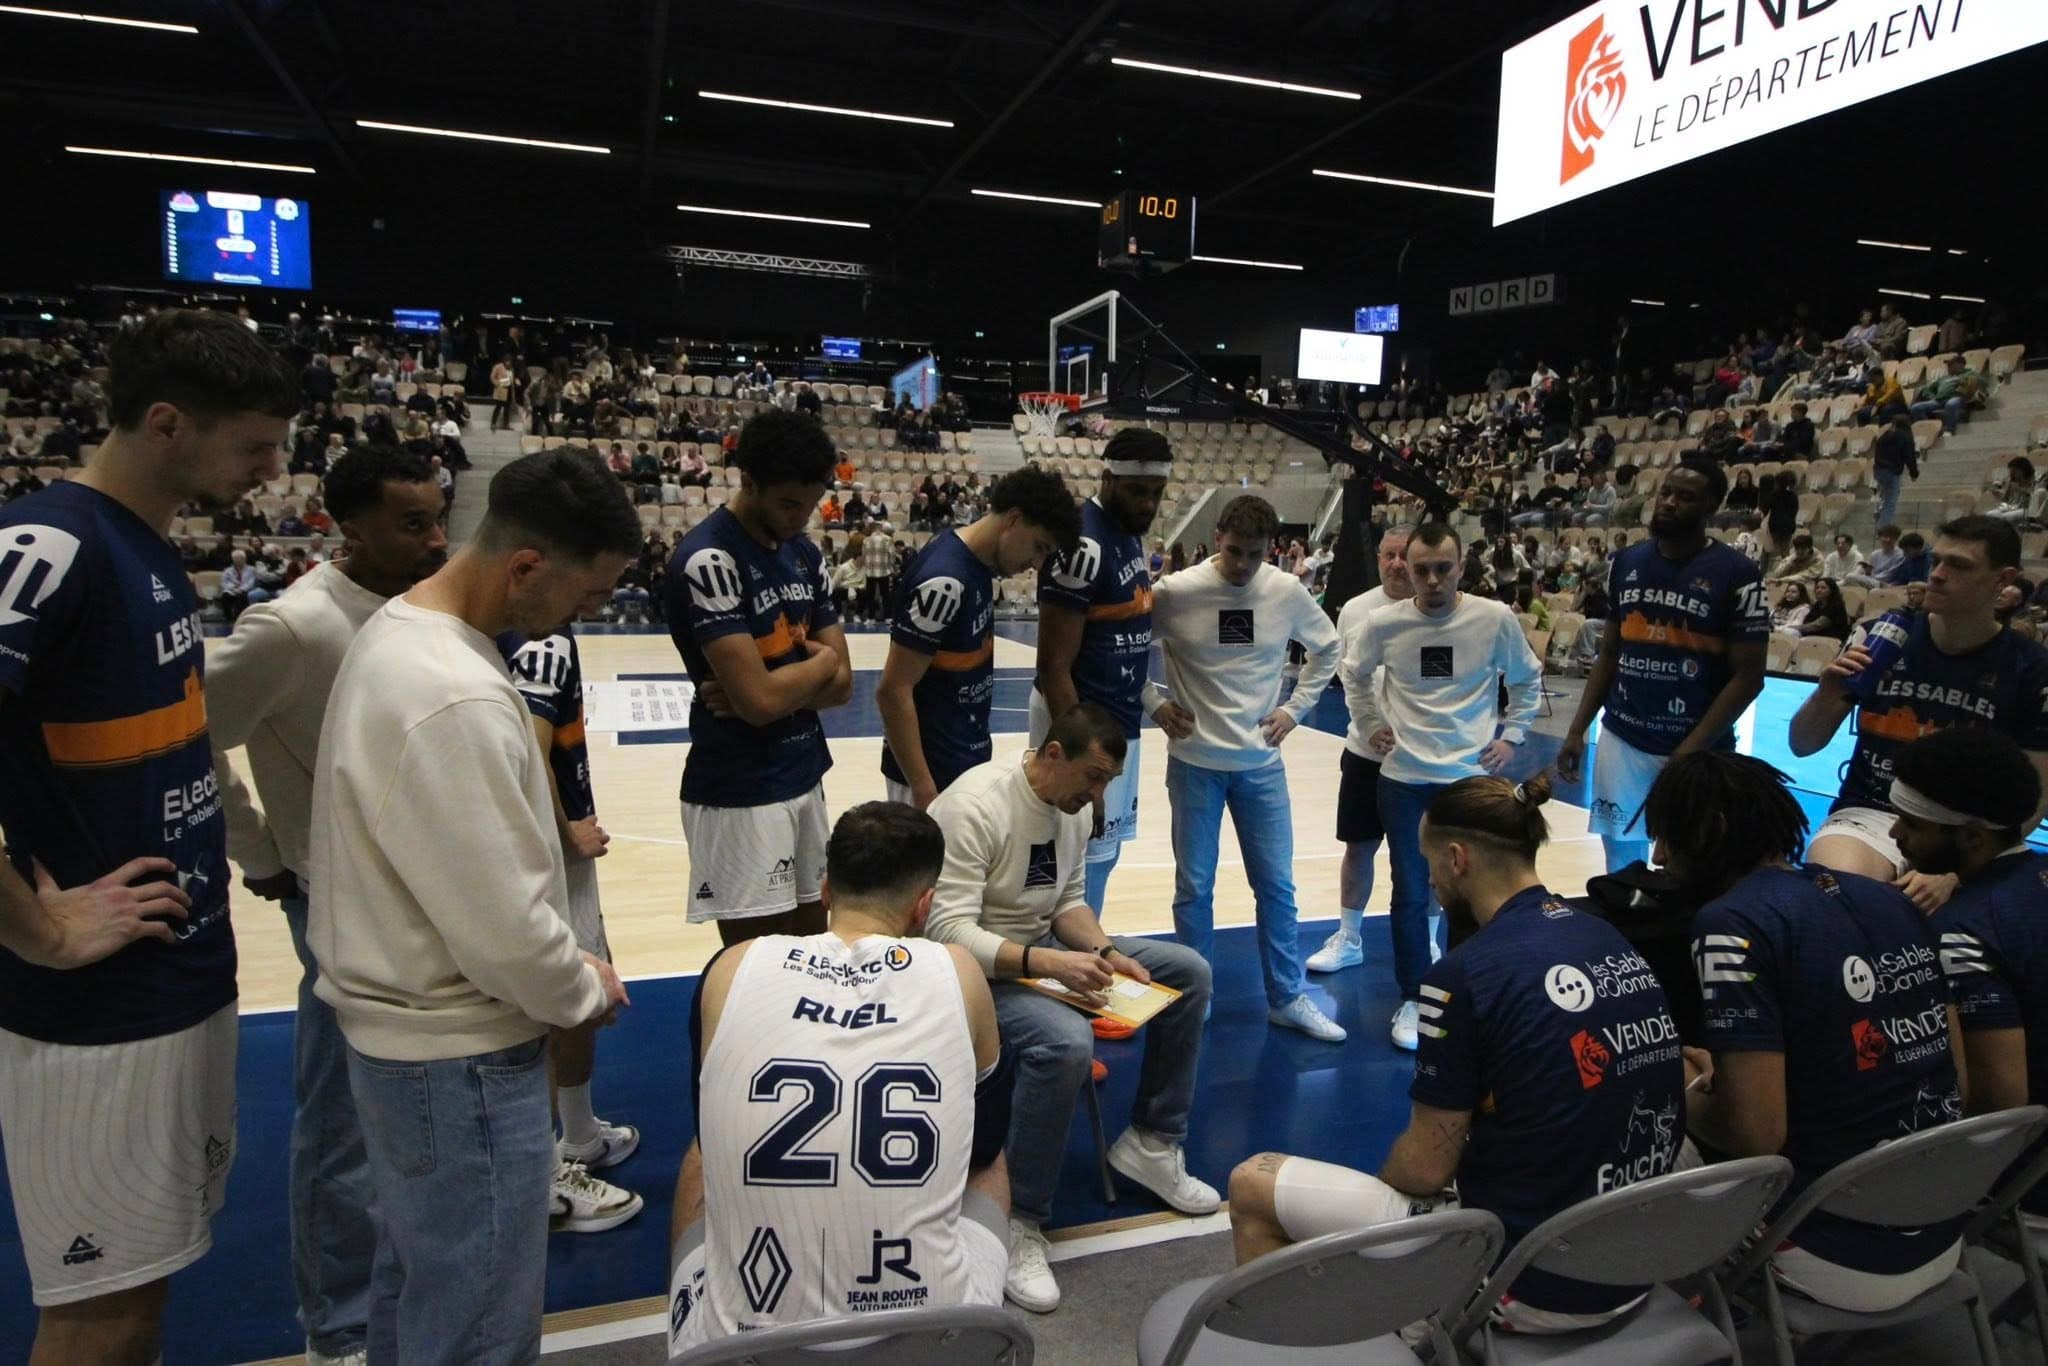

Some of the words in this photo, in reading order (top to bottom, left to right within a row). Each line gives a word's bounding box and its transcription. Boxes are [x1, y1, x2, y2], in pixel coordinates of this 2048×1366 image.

[1633, 104, 1670, 148] LE
[1677, 0, 1964, 133] DÉPARTEMENT
[1139, 196, 1178, 219] 10.0
[1454, 279, 1549, 310] NORD
[753, 587, 780, 616] LES
[1619, 588, 1642, 605] LES
[1643, 588, 1711, 618] SABLES
[1876, 680, 1914, 697] LES
[1916, 681, 1997, 720] SABLES
[1585, 961, 1611, 978] les
[1880, 944, 1936, 973] Sables
[792, 996, 898, 1030] RUEL
[1616, 1060, 1627, 1076] LE
[744, 1058, 941, 1187] 26
[847, 1289, 879, 1304] JEAN
[882, 1287, 928, 1303] ROUYER
